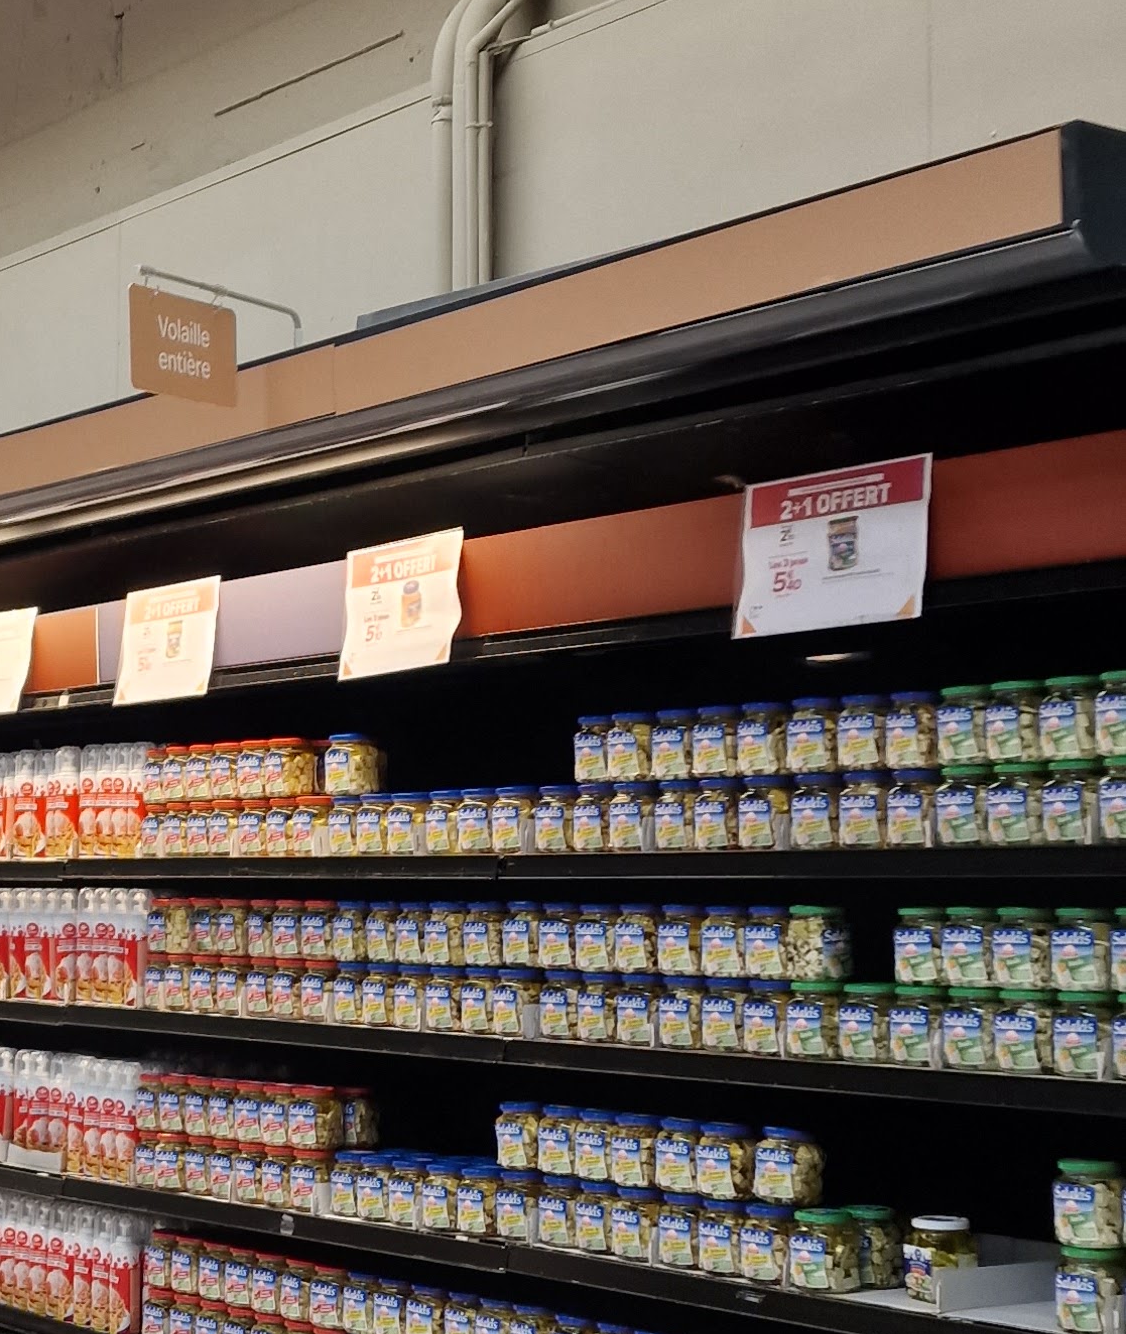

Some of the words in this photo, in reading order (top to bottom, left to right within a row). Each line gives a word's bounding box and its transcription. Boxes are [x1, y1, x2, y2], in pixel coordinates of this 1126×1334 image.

[157, 314, 211, 348] Volaille
[158, 350, 211, 379] entière
[780, 495, 812, 521] 2+1
[816, 483, 892, 513] OFFERT
[370, 563, 392, 583] 2+1
[393, 554, 437, 578] OFFERT
[162, 597, 201, 616] OFFERT
[937, 707, 972, 721] Salakis
[985, 706, 1017, 720] Salakis
[1039, 703, 1074, 717] Salakis
[789, 719, 821, 733] Salakis
[838, 716, 872, 730] Salakis
[886, 716, 916, 728] Salakis
[653, 729, 681, 742] Salakis
[694, 725, 723, 739] Salakis
[738, 722, 766, 736] Salakis
[608, 731, 635, 744] Salakis
[887, 795, 920, 807] Salakis
[937, 792, 974, 805] Salakis
[988, 790, 1024, 803] Salakis
[1043, 788, 1079, 801] Salakis
[695, 802, 724, 814] Salakis
[739, 800, 769, 813] Salakis
[792, 796, 827, 809] Salakis
[841, 795, 875, 808] Salakis
[610, 802, 638, 815] Salakis
[655, 802, 682, 815] Salakis
[703, 926, 735, 938] Salakis
[746, 927, 777, 939] Salakis
[896, 931, 931, 943] Salakis
[943, 929, 981, 942] Salakis
[993, 931, 1028, 944] Salakis
[1052, 932, 1091, 945] Salakis
[618, 996, 646, 1009] Salakis
[660, 999, 687, 1012] Salakis
[703, 999, 732, 1012] Salakis
[744, 1005, 773, 1018] Salakis
[787, 1007, 819, 1018] Salakis
[840, 1008, 871, 1020] Salakis
[890, 1012, 926, 1024] Salakis
[944, 1013, 978, 1027] Salakis
[996, 1019, 1032, 1031] Salakis
[1055, 1020, 1095, 1033] Salakis
[539, 1130, 566, 1141] Salakis
[576, 1134, 604, 1146] Salakis
[656, 1141, 689, 1154] Salakis
[697, 1148, 729, 1159] Salakis
[757, 1149, 790, 1162] Salakis
[1054, 1185, 1092, 1201] Salakis
[539, 1197, 565, 1211] Salakis
[577, 1205, 603, 1217] Salakis
[612, 1211, 638, 1223] Salakis
[660, 1218, 689, 1230] Salakis
[700, 1225, 729, 1237] Salakis
[741, 1232, 770, 1244] Salakis
[791, 1238, 823, 1252] Salakis
[226, 1264, 247, 1276] Salakis
[253, 1270, 274, 1281] Salakis
[311, 1282, 335, 1295] Salakis
[1057, 1277, 1094, 1292] Salakis
[344, 1287, 365, 1300] Salakis
[144, 1304, 163, 1317] Salakis
[407, 1302, 431, 1315] Salakis
[170, 1310, 191, 1322] Salakis
[445, 1310, 468, 1323] Salakis
